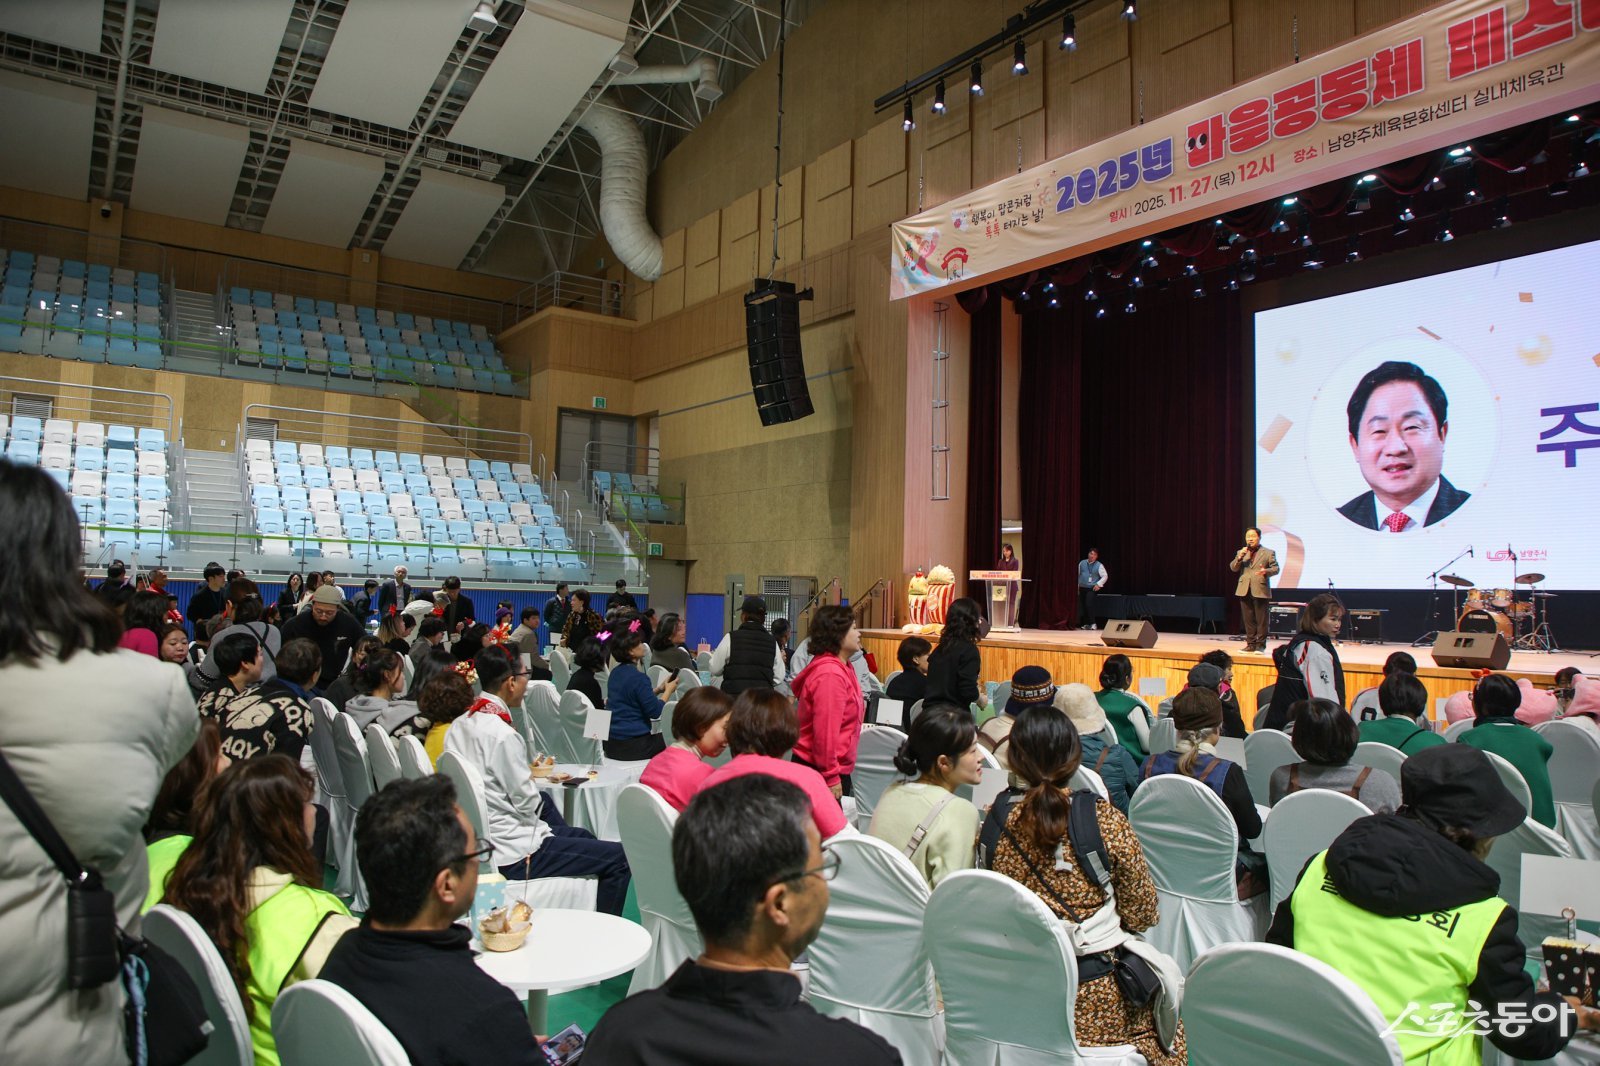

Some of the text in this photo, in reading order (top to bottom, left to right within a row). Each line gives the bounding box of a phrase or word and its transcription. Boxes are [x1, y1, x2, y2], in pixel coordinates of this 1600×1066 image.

[1055, 0, 1600, 214] 2025년 마을공동체 페스
[1293, 62, 1566, 163] 장소 남양주체육문화센터 실내체육관
[971, 194, 1032, 226] 행복이 팝콘처럼
[1003, 213, 1029, 230] 터지는
[1032, 208, 1044, 223] 날!
[1108, 204, 1128, 222] 일시
[1134, 195, 1167, 215] 2025.
[1238, 153, 1276, 183] 12시
[1536, 402, 1600, 468] 주
